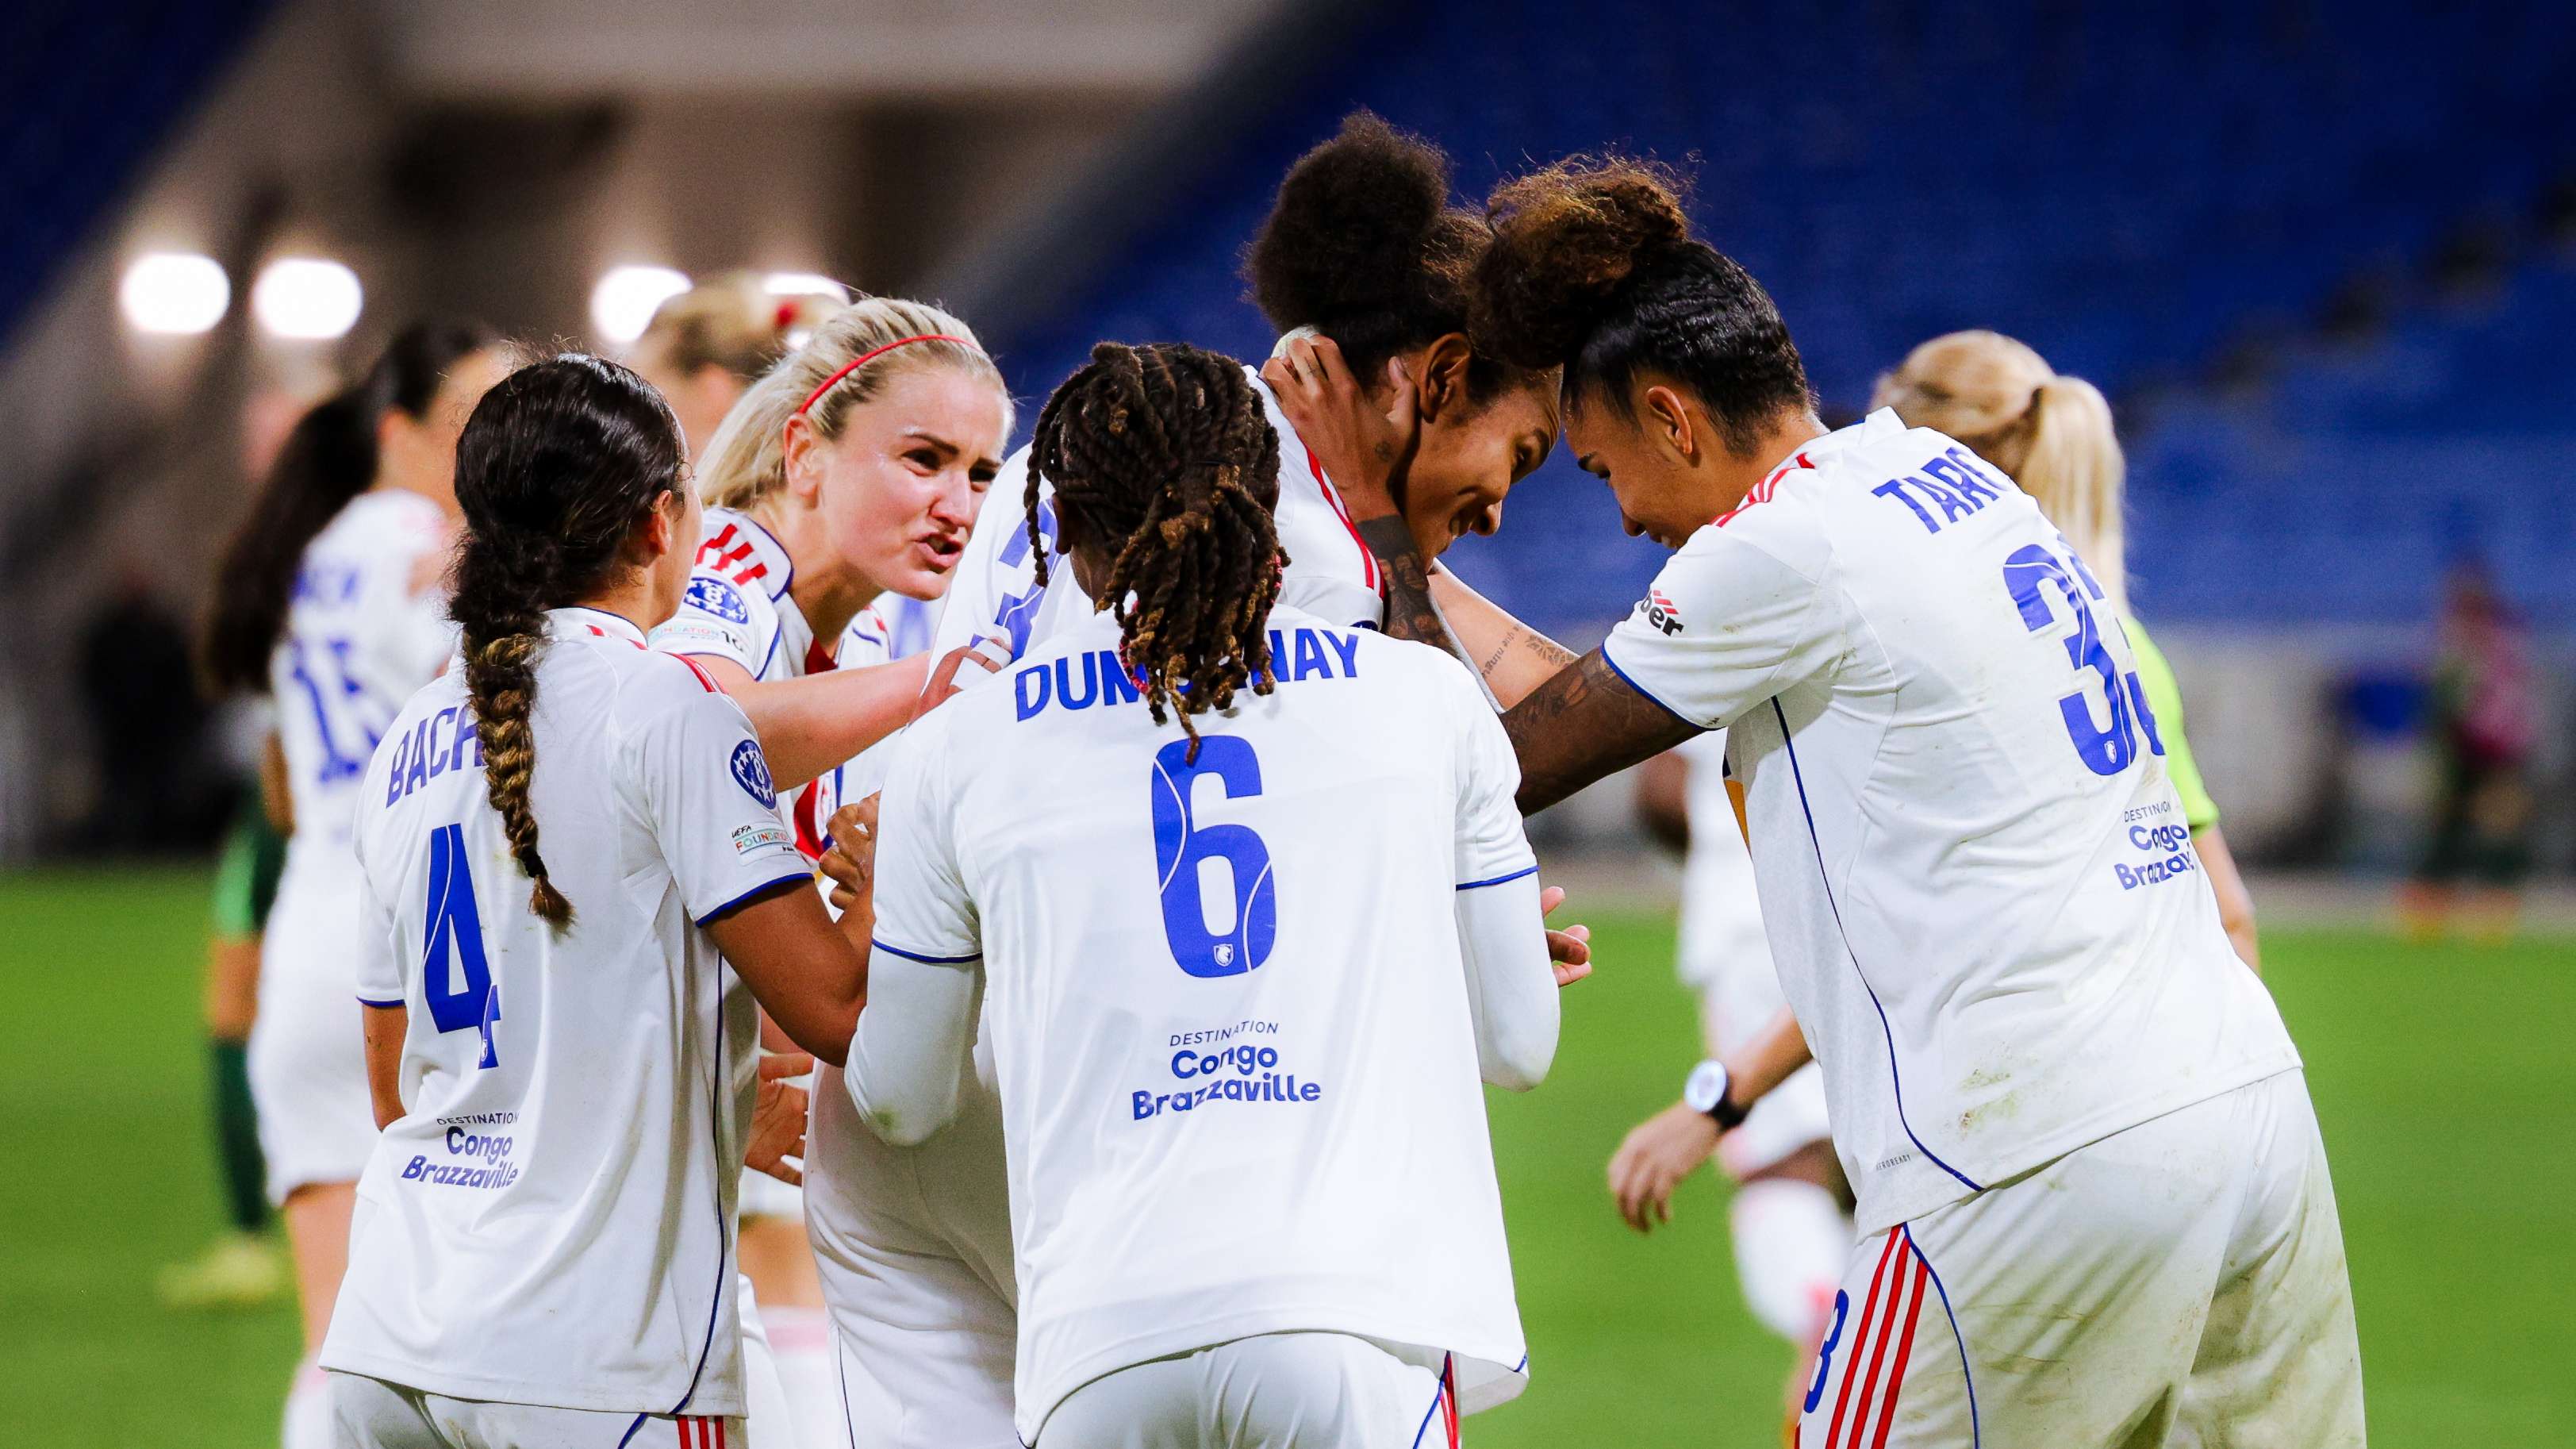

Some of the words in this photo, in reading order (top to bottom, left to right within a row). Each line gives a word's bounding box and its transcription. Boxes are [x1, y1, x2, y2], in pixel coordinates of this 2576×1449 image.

[1641, 590, 1684, 636] ber
[1015, 628, 1359, 721] DUMNAY
[386, 705, 487, 809] BACH
[731, 824, 751, 839] UEFA
[1151, 734, 1276, 978] 6
[423, 823, 502, 1070] 4
[1170, 1020, 1279, 1047] DESTINATION
[1171, 1044, 1278, 1080] Congo
[1132, 1071, 1323, 1120] Brazzaville
[437, 1113, 519, 1125] DESTINATION
[446, 1126, 513, 1165] Congo
[401, 1155, 519, 1190] Brazzaville
